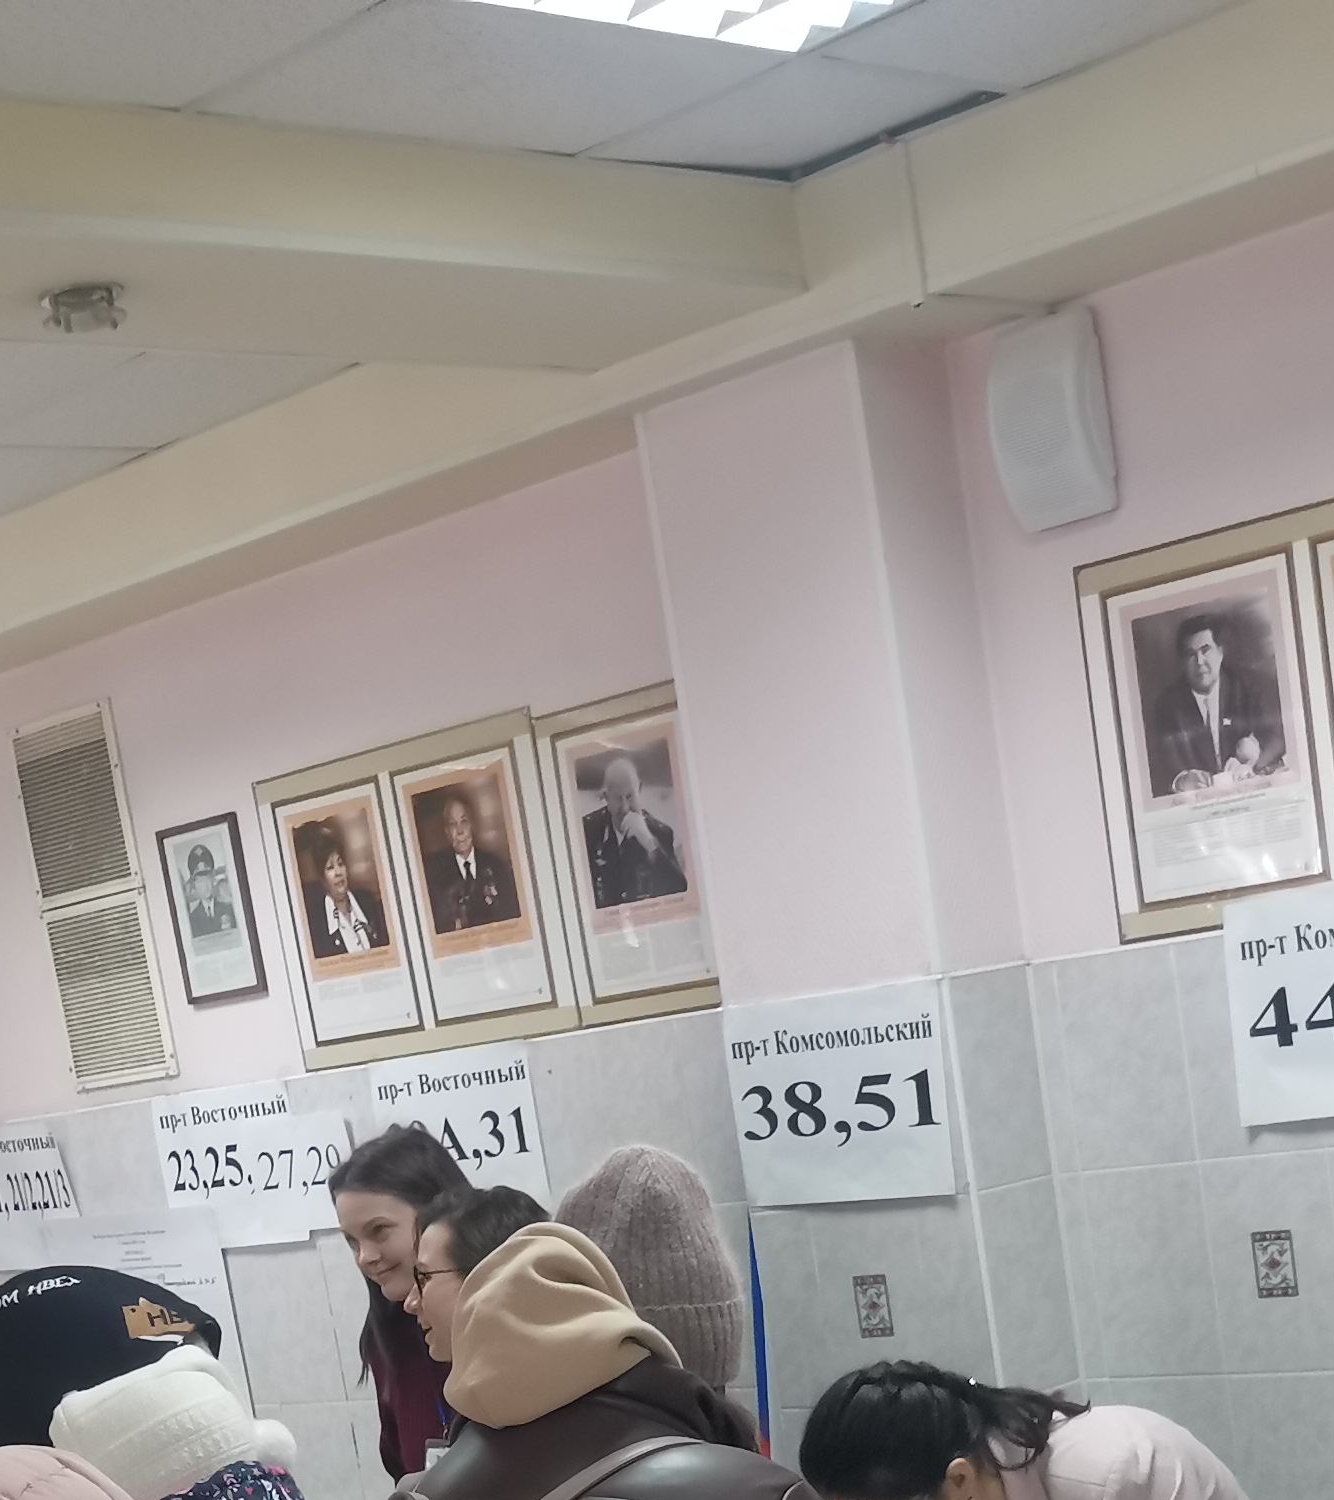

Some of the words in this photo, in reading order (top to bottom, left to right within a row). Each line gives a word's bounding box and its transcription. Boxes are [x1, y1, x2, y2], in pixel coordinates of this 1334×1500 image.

[1240, 934, 1288, 967] пр-т
[731, 1038, 771, 1066] пр-т
[773, 1011, 934, 1056] Комсомольский
[378, 1080, 414, 1105] пр-т
[417, 1058, 527, 1096] Восточный
[159, 1112, 188, 1134] пр-т
[191, 1093, 288, 1127] Восточный
[741, 1068, 943, 1148] 38,51
